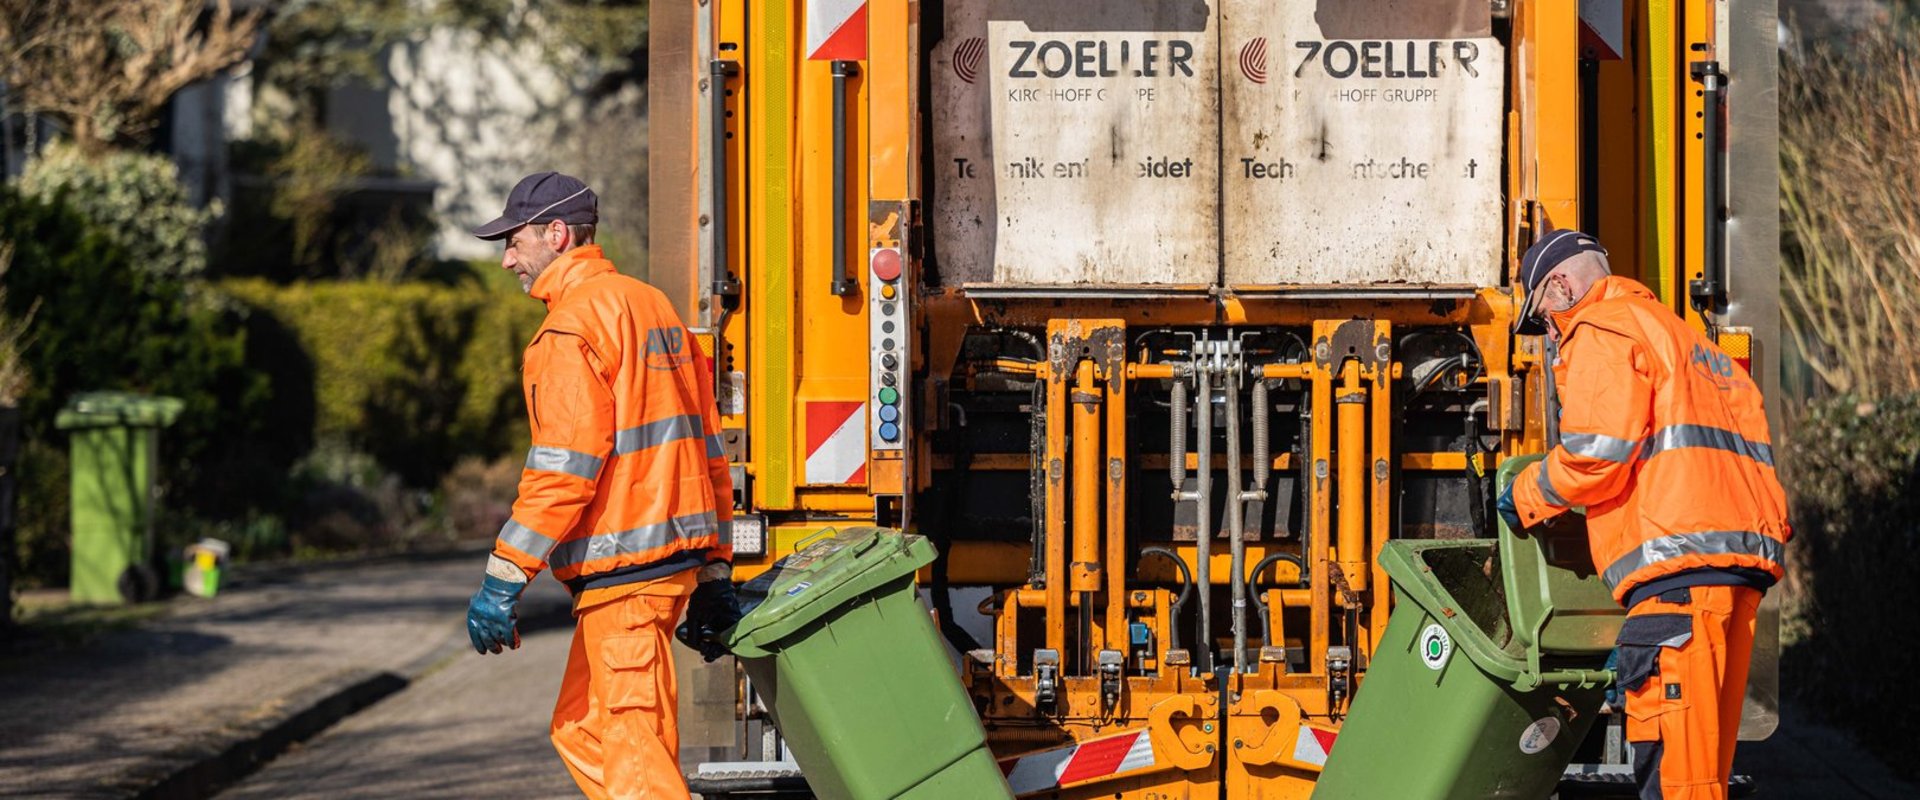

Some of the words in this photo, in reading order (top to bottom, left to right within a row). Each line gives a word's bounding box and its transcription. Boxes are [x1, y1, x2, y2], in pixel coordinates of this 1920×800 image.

[1009, 40, 1194, 78] ZOELLER
[953, 156, 1045, 179] Tenik
[1240, 156, 1297, 179] Tech
